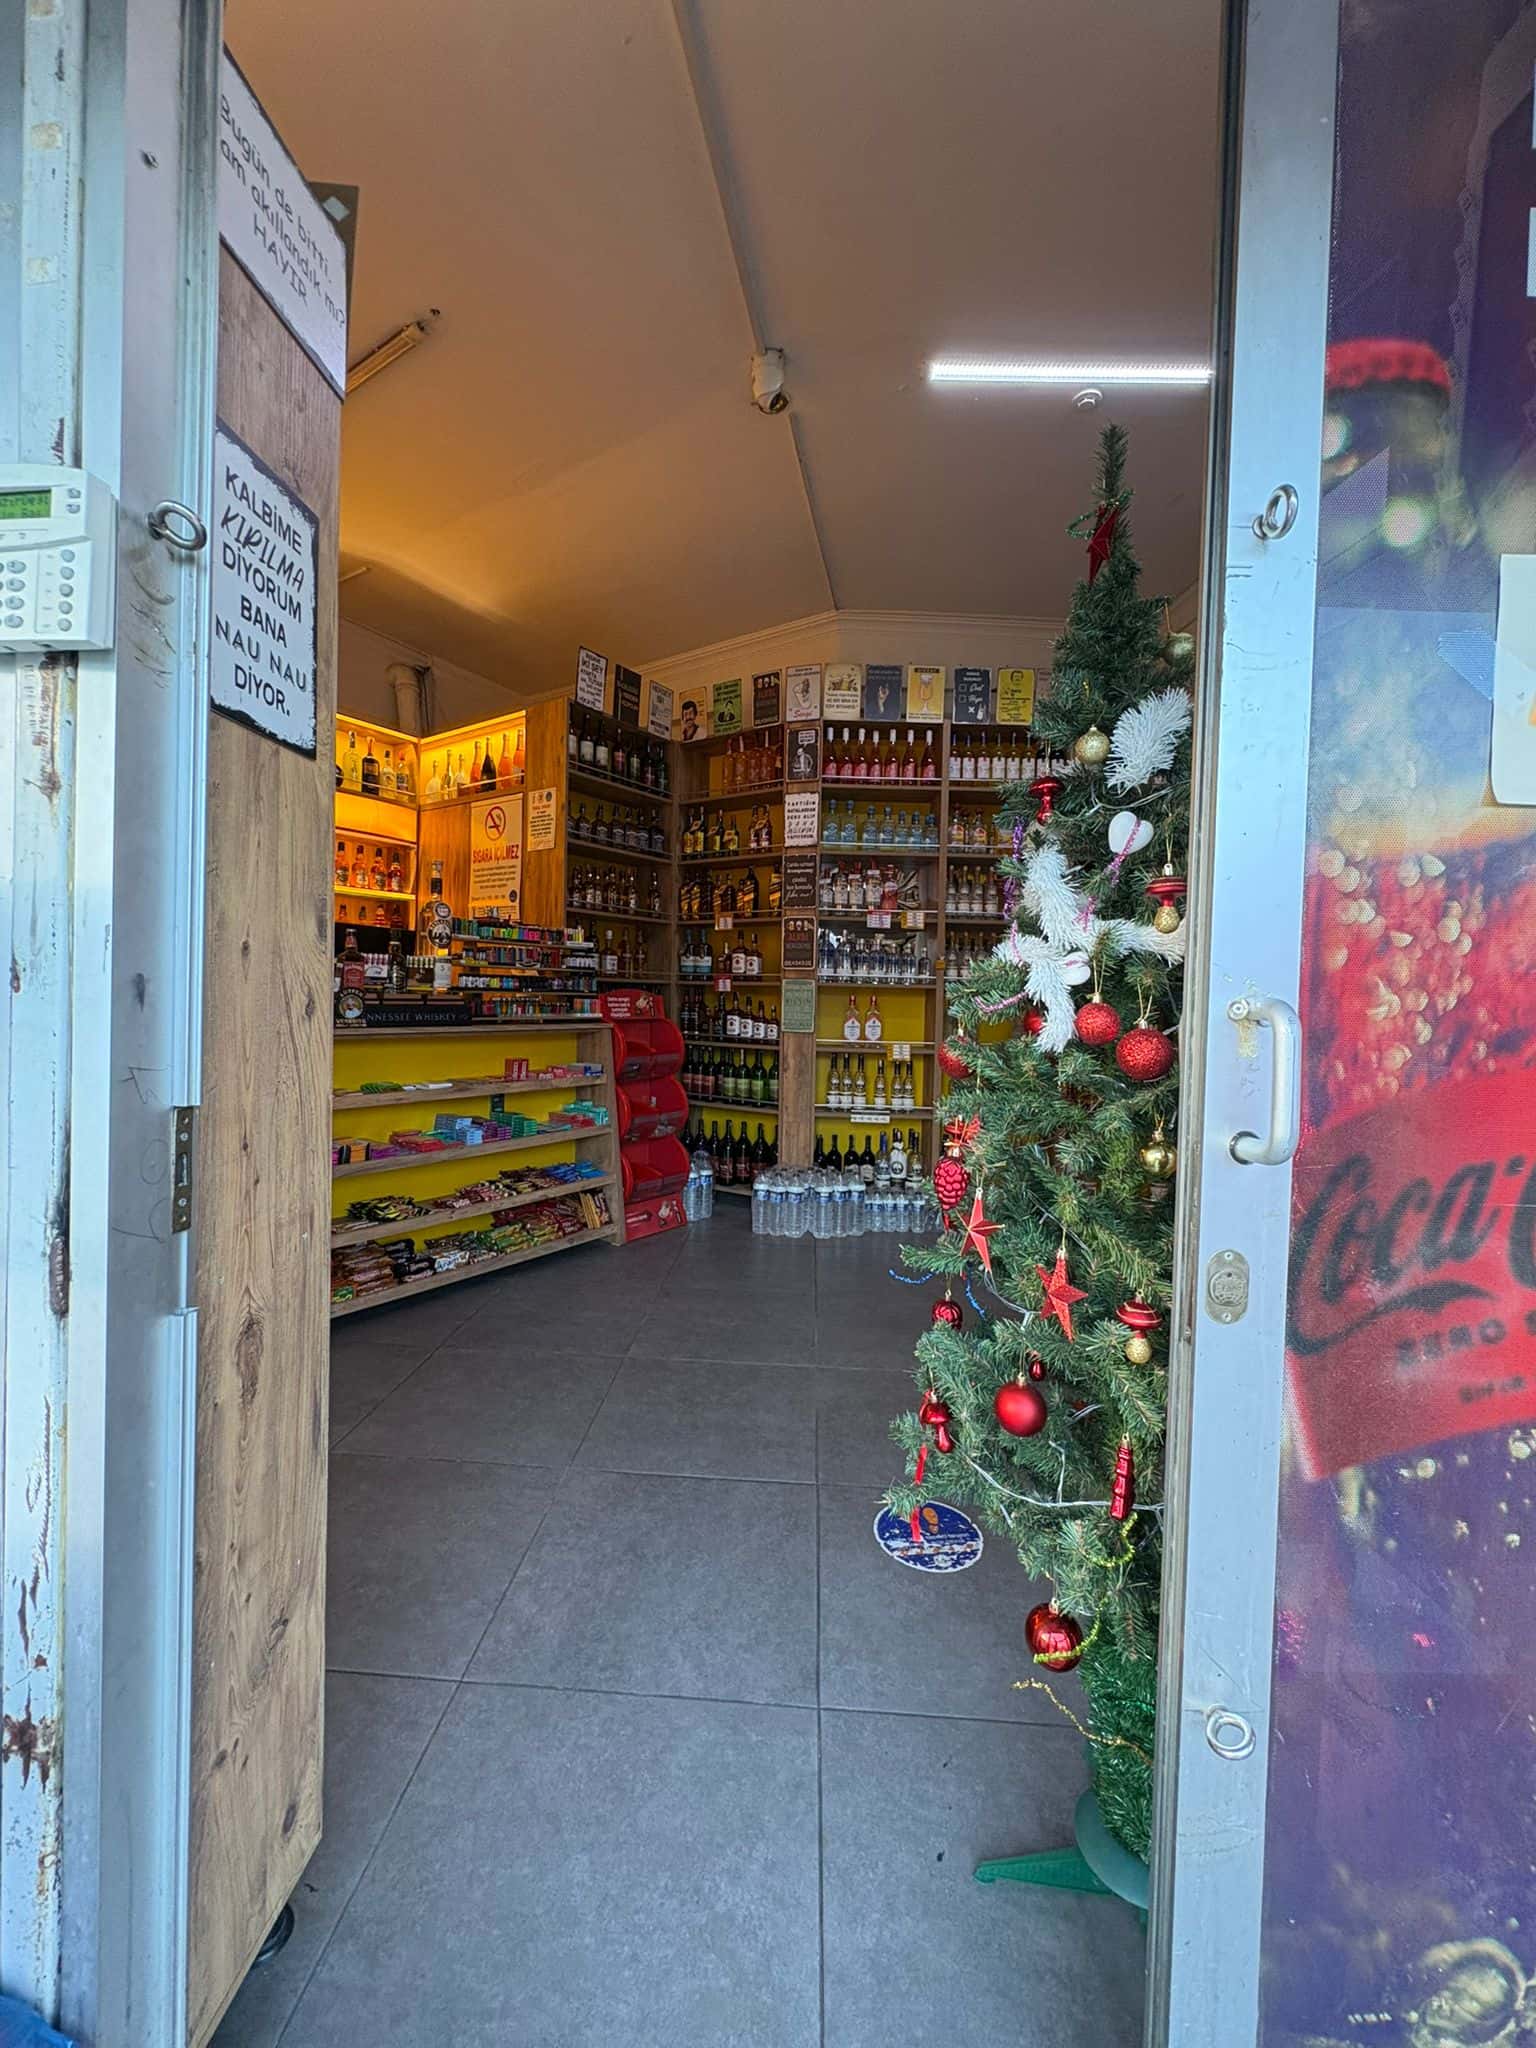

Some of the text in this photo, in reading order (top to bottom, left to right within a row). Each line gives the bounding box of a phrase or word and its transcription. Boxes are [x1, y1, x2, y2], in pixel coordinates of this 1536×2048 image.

[251, 185, 321, 296] akıllandık
[254, 212, 308, 308] HAYIR
[274, 187, 293, 223] de
[298, 215, 332, 284] bitti.
[220, 505, 305, 593] KIRILMA
[225, 465, 302, 556] KALBİME
[222, 541, 302, 624] DİYORUM
[240, 594, 287, 648] BANA
[215, 613, 307, 693] NAU NAU
[234, 663, 290, 717] DİYOR.
[367, 1012, 410, 1021] NNESSEE
